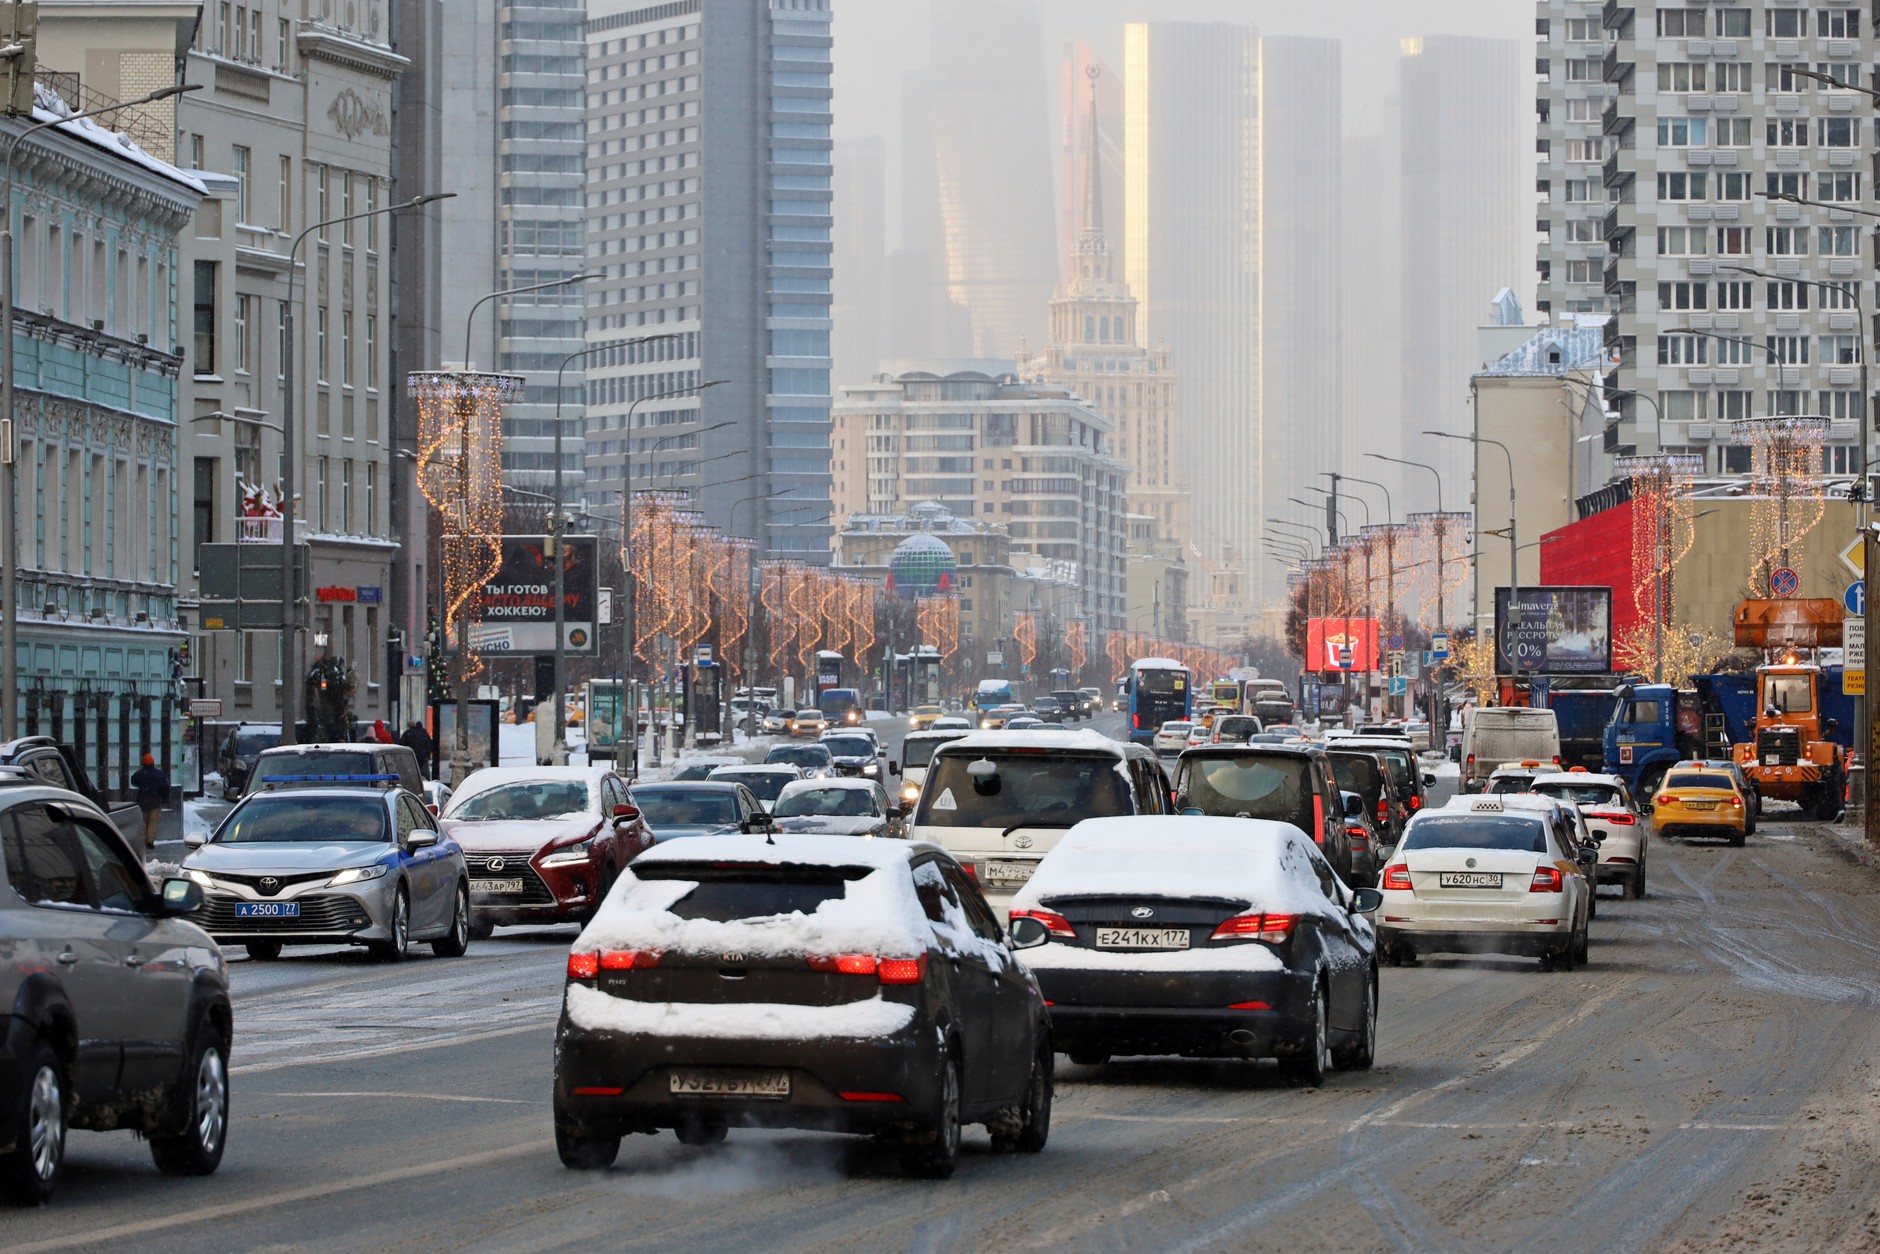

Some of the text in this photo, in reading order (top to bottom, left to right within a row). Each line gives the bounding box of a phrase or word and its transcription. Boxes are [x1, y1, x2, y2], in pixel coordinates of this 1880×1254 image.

[485, 585, 548, 594] ТЫ ГОТОВ
[487, 606, 547, 616] ХОККЕЮ?
[1445, 874, 1498, 884] У620НС 30
[241, 903, 296, 915] А 2500 77
[1101, 930, 1185, 945] Е241КХ 177
